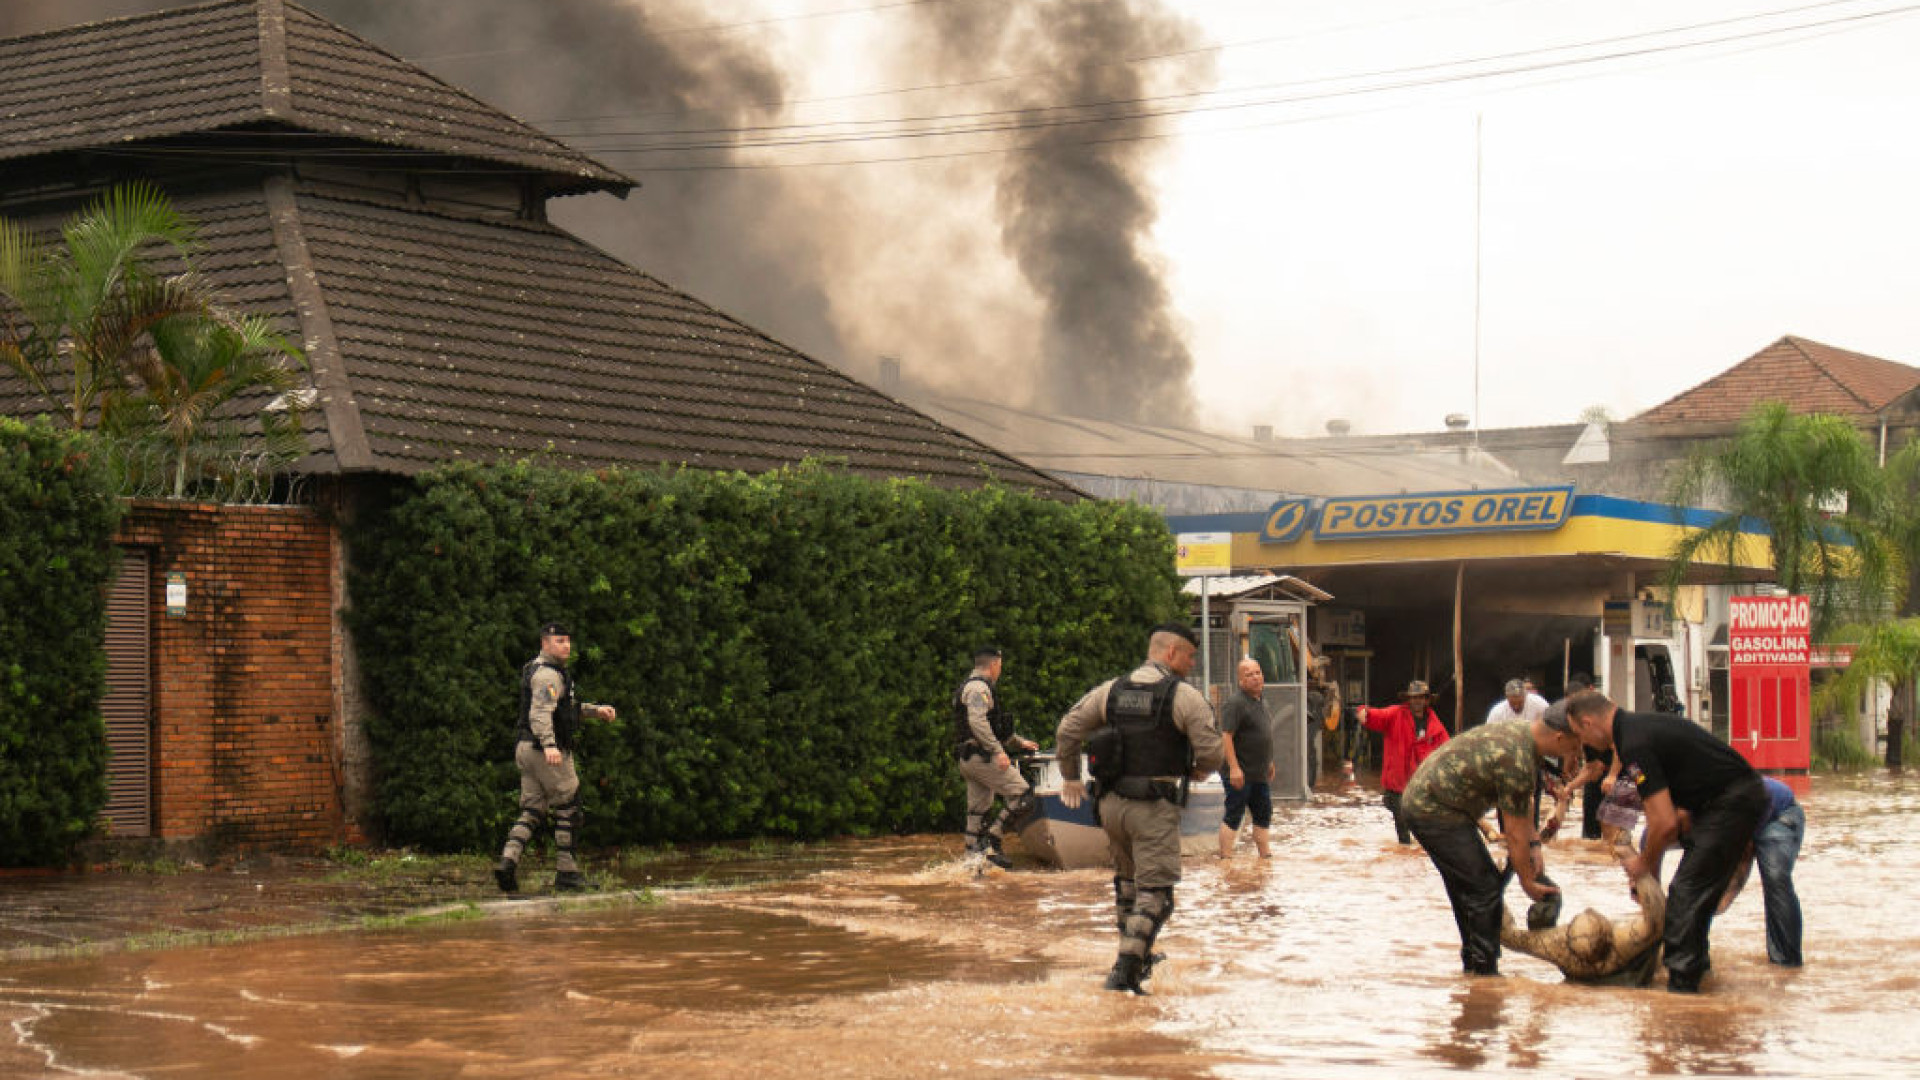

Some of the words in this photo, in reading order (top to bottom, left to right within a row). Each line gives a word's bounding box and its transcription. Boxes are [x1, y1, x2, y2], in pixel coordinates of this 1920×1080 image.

[1330, 501, 1462, 529] POSTOS
[1471, 495, 1557, 522] OREL
[1730, 597, 1808, 634] PROMOÇÃO
[1732, 636, 1807, 650] GASOLINA
[1734, 652, 1805, 662] ADITIVADA
